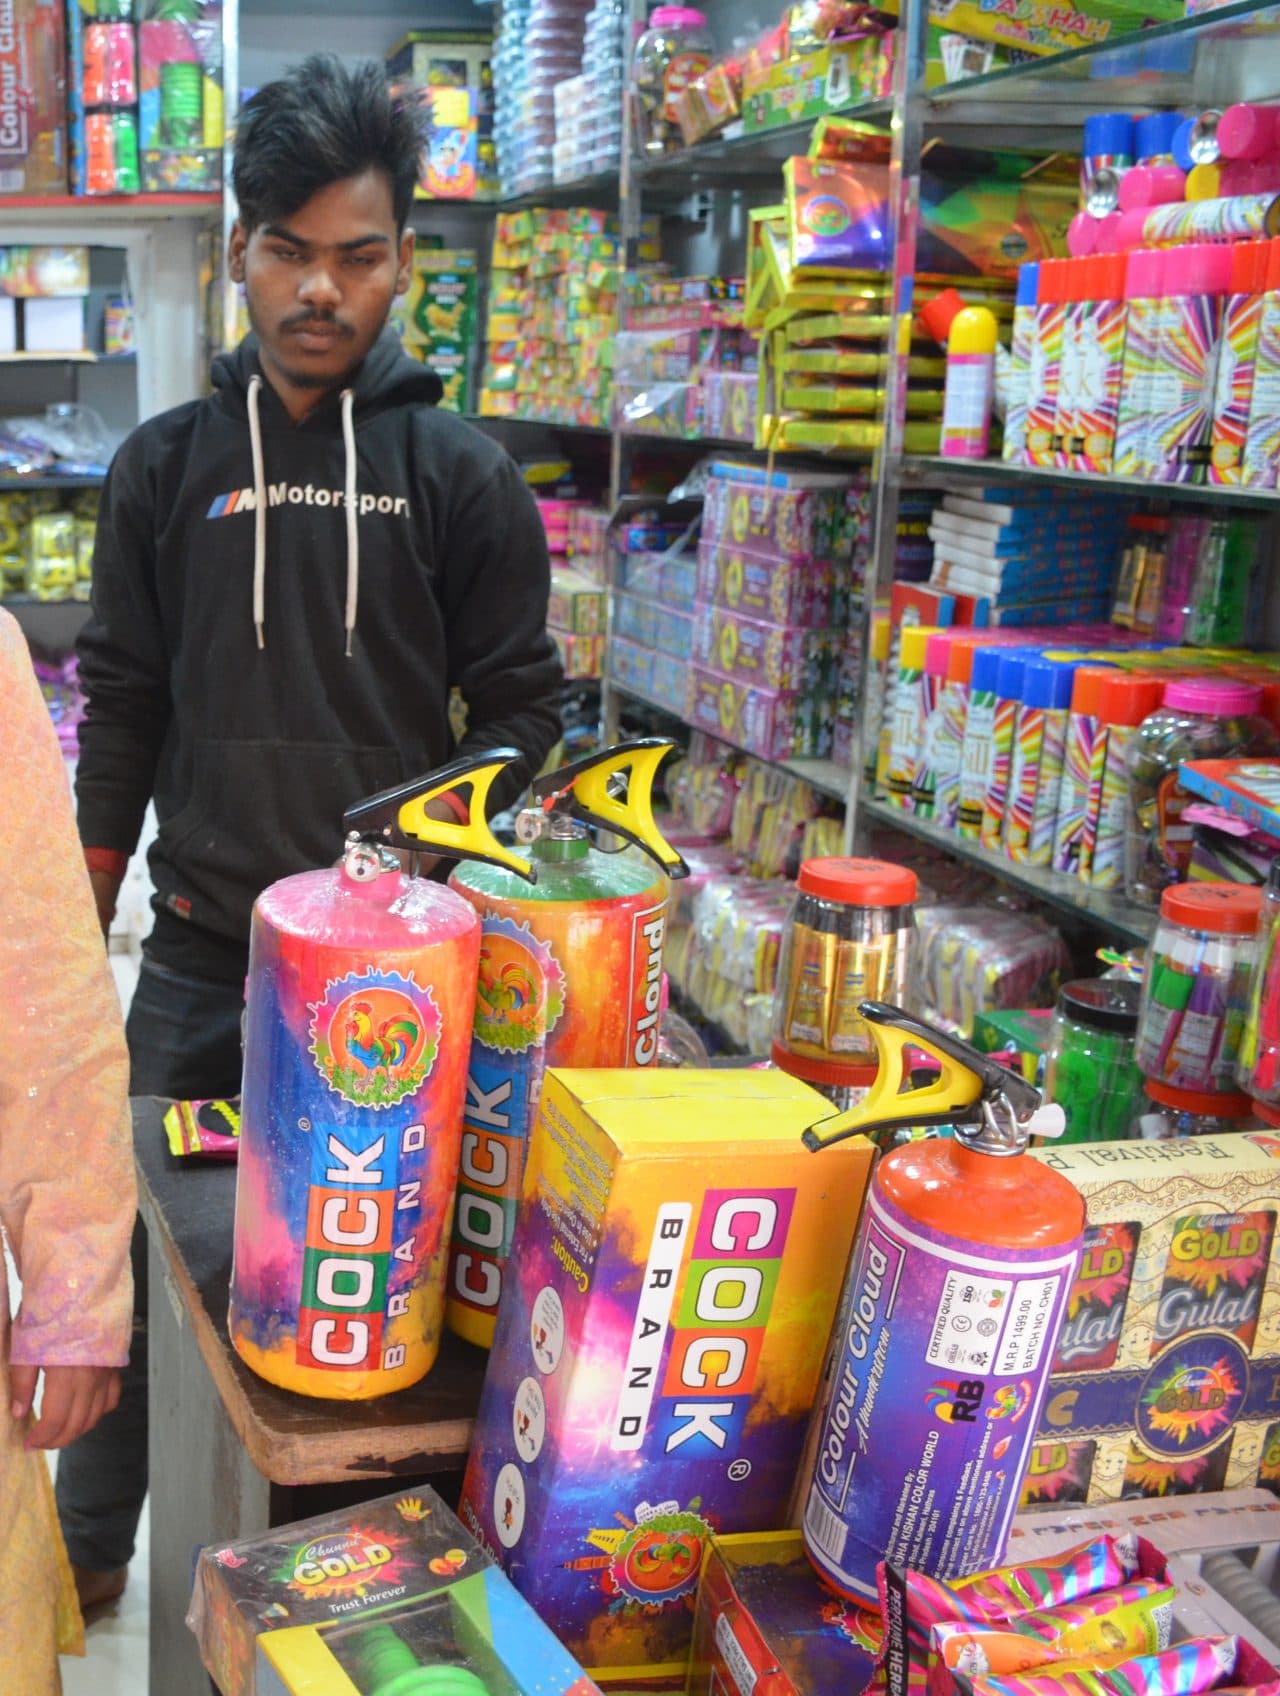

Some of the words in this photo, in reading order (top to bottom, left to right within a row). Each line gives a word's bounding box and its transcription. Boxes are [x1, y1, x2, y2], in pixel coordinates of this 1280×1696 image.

[0, 62, 18, 146] Colour
[635, 917, 664, 1065] Cloud
[1089, 1141, 1234, 1167] Festival
[455, 1072, 512, 1307] COCK
[311, 1132, 385, 1365] COCK
[383, 1123, 426, 1370] BRAND
[551, 1236, 590, 1293] Caution:
[1078, 1248, 1125, 1281] LD
[1171, 1228, 1261, 1261] GOLD
[963, 1285, 974, 1303] ISO
[1156, 1286, 1258, 1342] Gulal
[619, 1218, 683, 1436] BRAND
[665, 1197, 778, 1453] COCK
[929, 1315, 948, 1358] CERTIFIED
[941, 1277, 957, 1315] QUALITY
[1014, 1299, 1032, 1338] 1499.00
[821, 1362, 859, 1485] Colour
[848, 1240, 888, 1360] Cloud
[1023, 1334, 1040, 1369] BATCH
[950, 1380, 984, 1422] RB
[1155, 1388, 1226, 1414] GOLD
[920, 1430, 939, 1468] WORLD
[911, 1469, 928, 1504] COLOR
[900, 1505, 919, 1541] KISHAN
[294, 1544, 392, 1585] GOLD
[305, 1538, 360, 1560] Chunnu
[894, 1542, 909, 1568] ADHA
[329, 1598, 360, 1614] Trust
[362, 1585, 406, 1604] Forever
[888, 1586, 903, 1653] PERFUME
